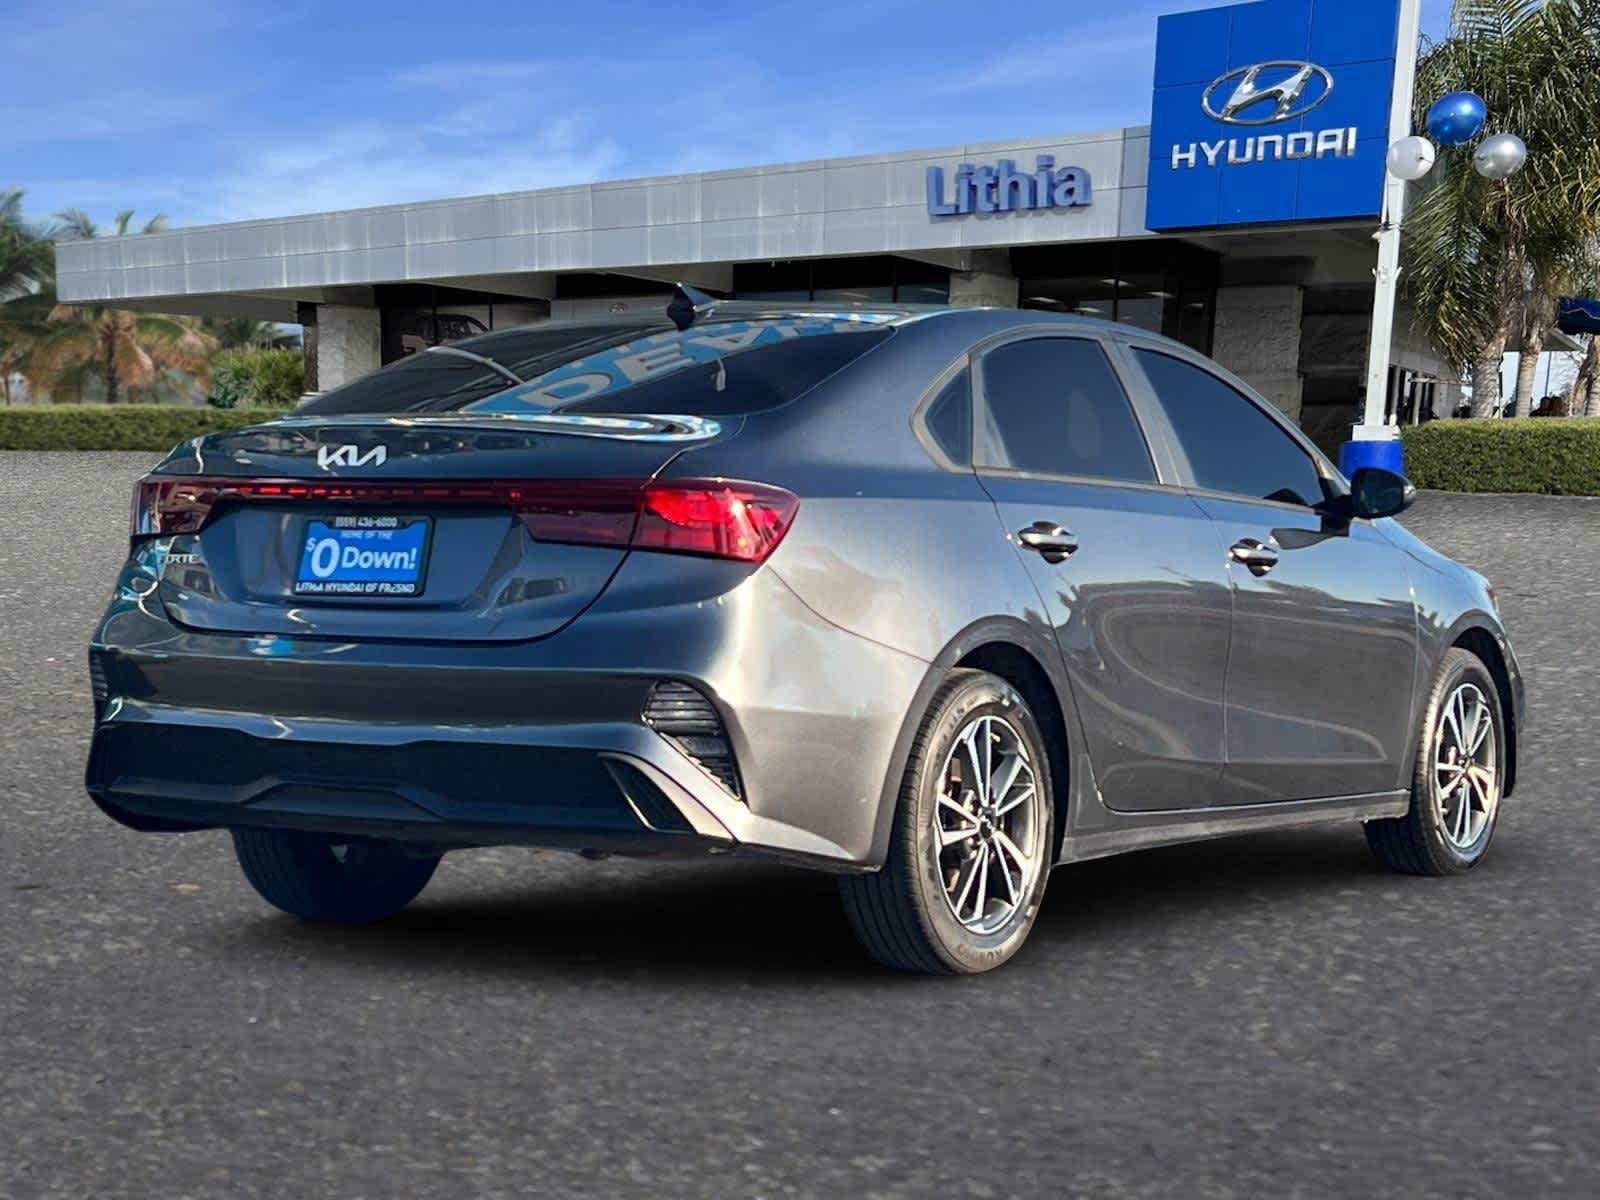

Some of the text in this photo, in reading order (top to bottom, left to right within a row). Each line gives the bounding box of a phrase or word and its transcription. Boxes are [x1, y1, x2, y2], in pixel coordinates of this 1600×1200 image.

[1171, 127, 1358, 169] HYUNDAI
[926, 154, 1092, 216] Lithia
[316, 445, 387, 468] KIA
[342, 546, 418, 570] Down!
